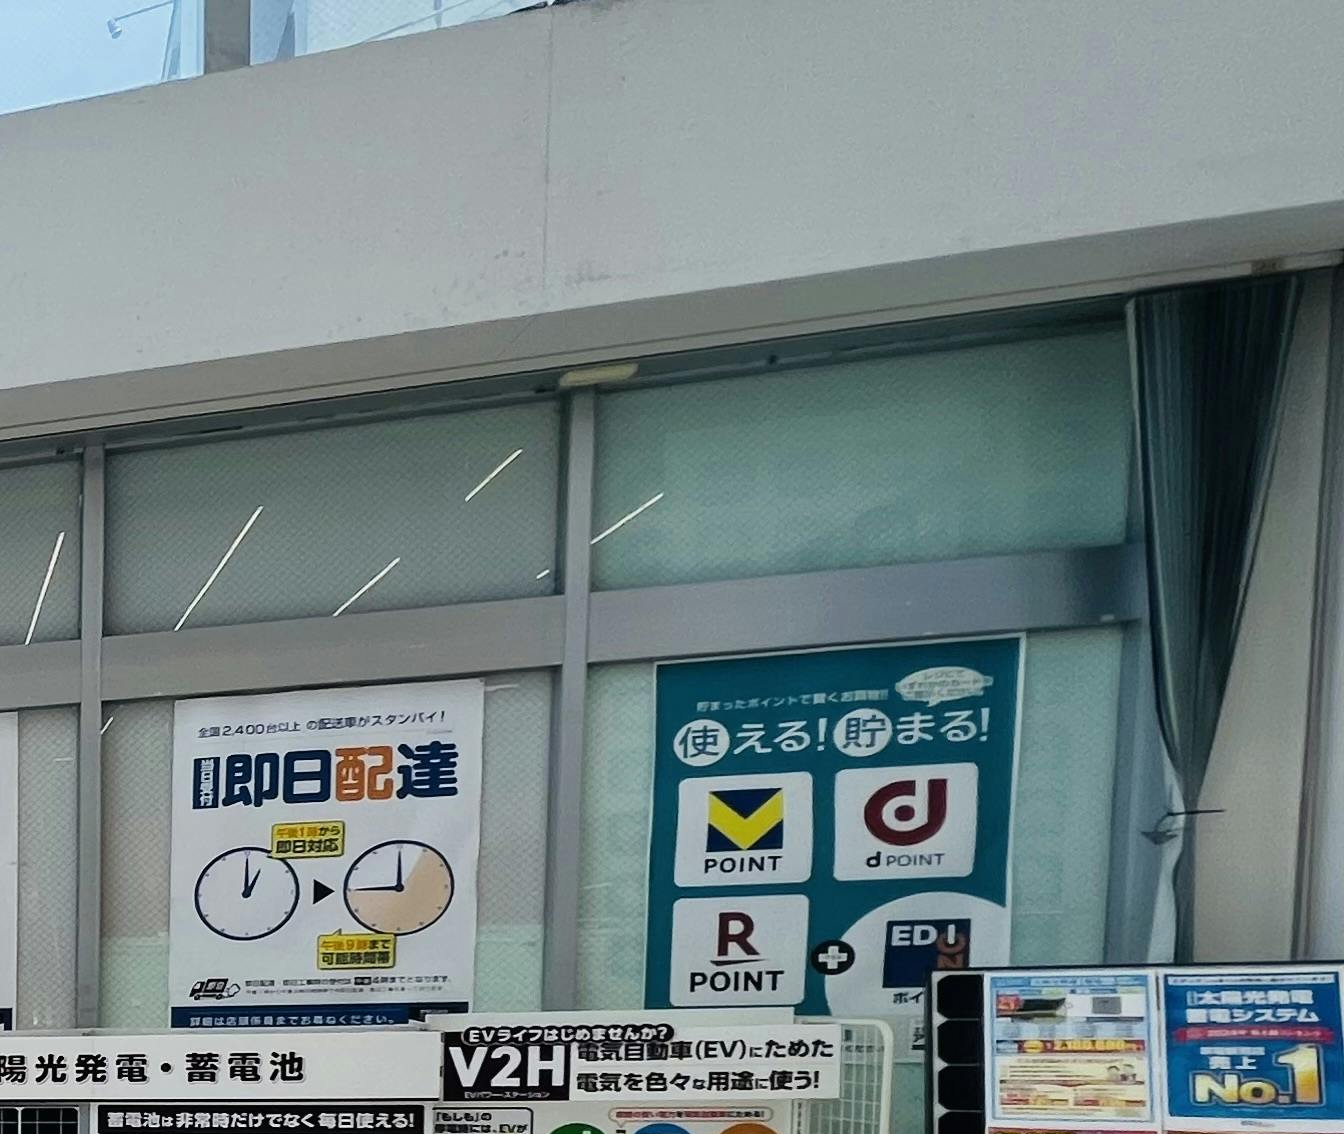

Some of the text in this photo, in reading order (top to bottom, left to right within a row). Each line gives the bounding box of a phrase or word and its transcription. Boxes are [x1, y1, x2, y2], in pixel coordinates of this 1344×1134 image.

[678, 707, 991, 759] 使える! 貯まる!
[199, 759, 214, 807] 当日受付
[222, 741, 459, 807] 即日配達
[276, 838, 339, 854] 即日対応
[703, 855, 783, 874] POINT
[866, 851, 946, 869] d POINT
[716, 911, 761, 957] R
[689, 970, 785, 993] POINT
[893, 992, 923, 1004] ポイ
[469, 1026, 669, 1043] EVライフはじめませんか?
[577, 1039, 834, 1063] 電気自動車(EV)にためた
[448, 1044, 567, 1089] V2H
[1194, 1045, 1321, 1105] No.1
[576, 1071, 820, 1093] 電気を色々な用途に使う!
[436, 1112, 492, 1121] 「もしも」の
